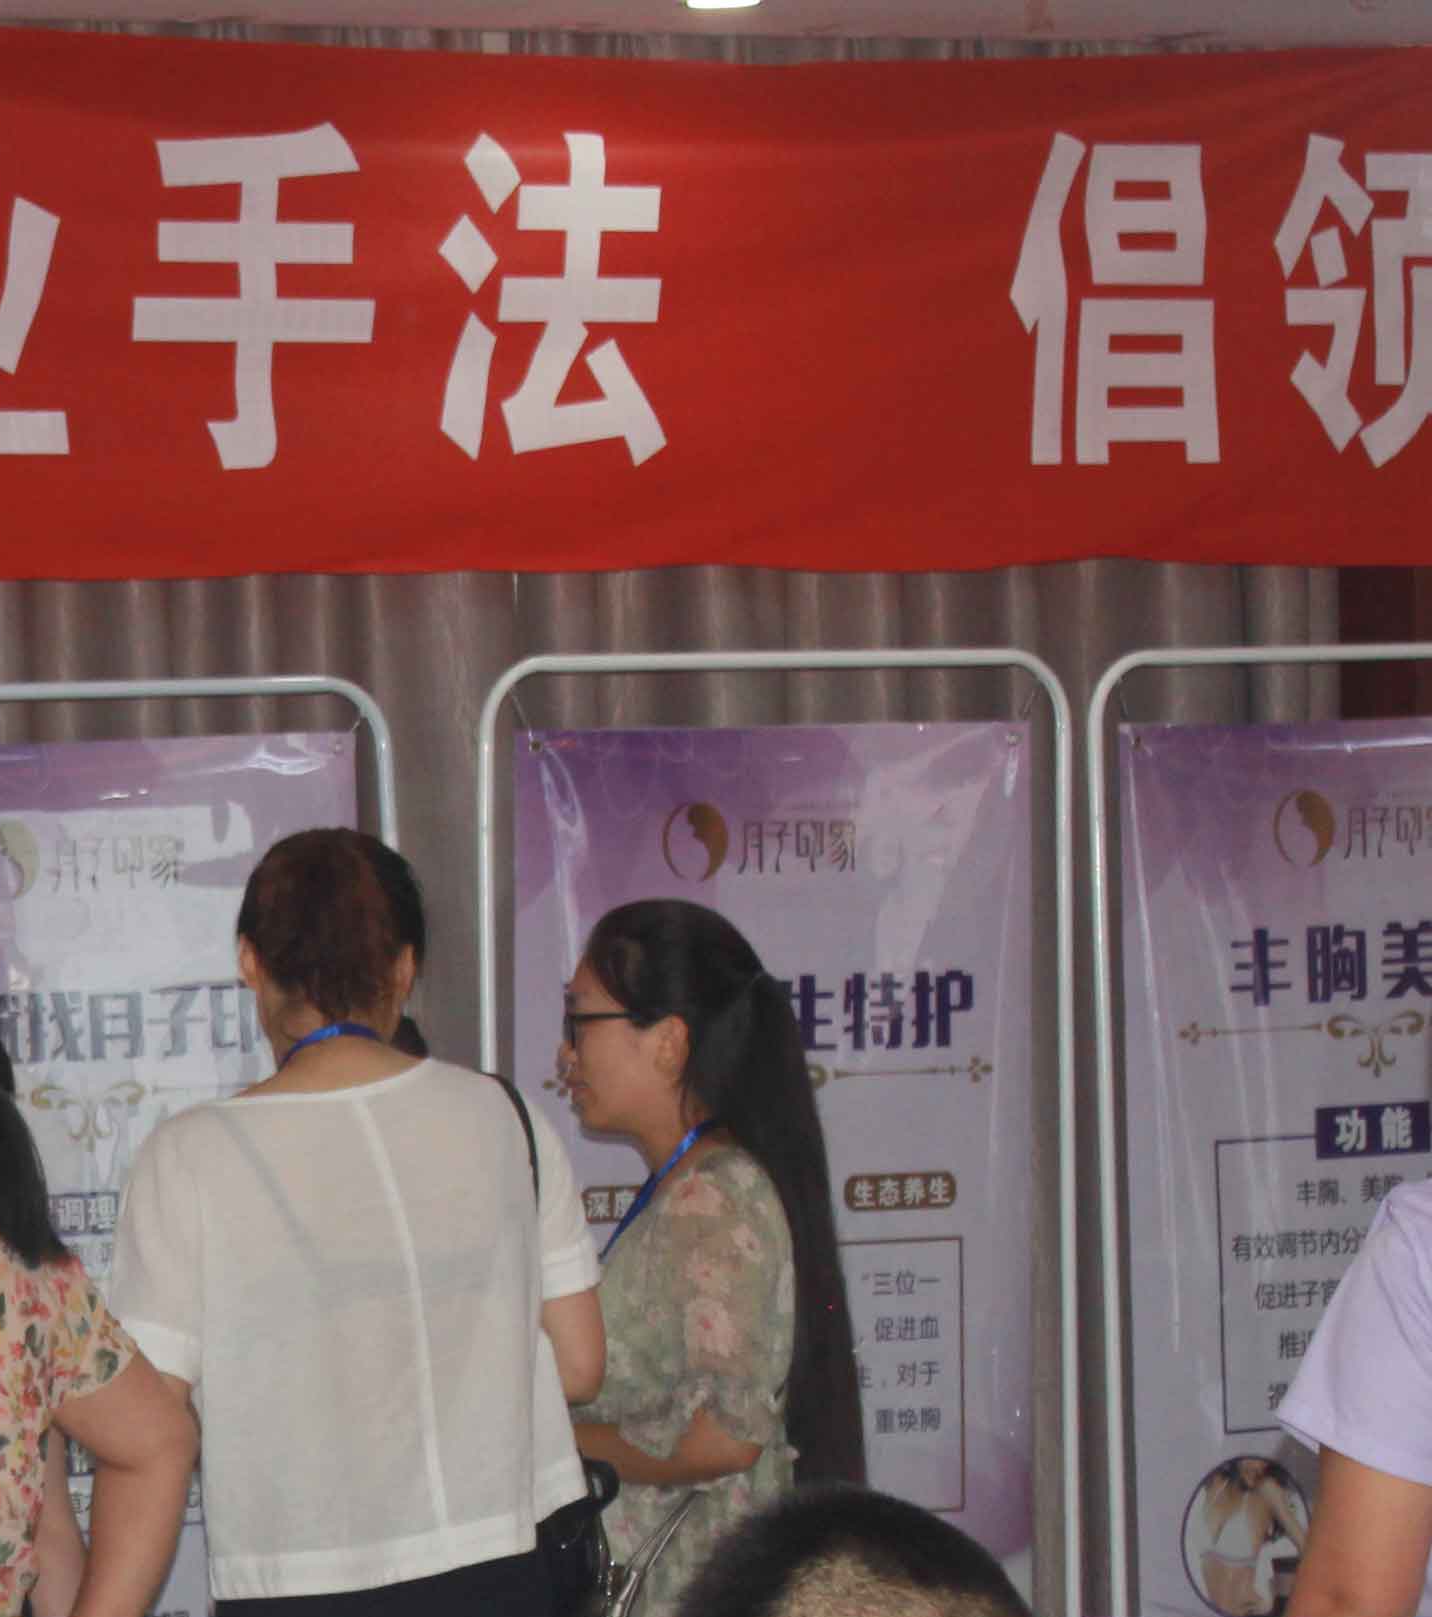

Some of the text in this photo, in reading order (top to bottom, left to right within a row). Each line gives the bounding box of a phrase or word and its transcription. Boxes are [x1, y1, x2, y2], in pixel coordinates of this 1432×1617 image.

[1011, 131, 1432, 467] 倡领
[737, 819, 857, 874] 月子印象
[1344, 806, 1432, 859] 月子印
[1230, 921, 1432, 1005] 丰胸美
[1335, 1106, 1412, 1152] 功能
[853, 1174, 953, 1208] 生态养生
[1232, 1227, 1370, 1263] 有效调节内分
